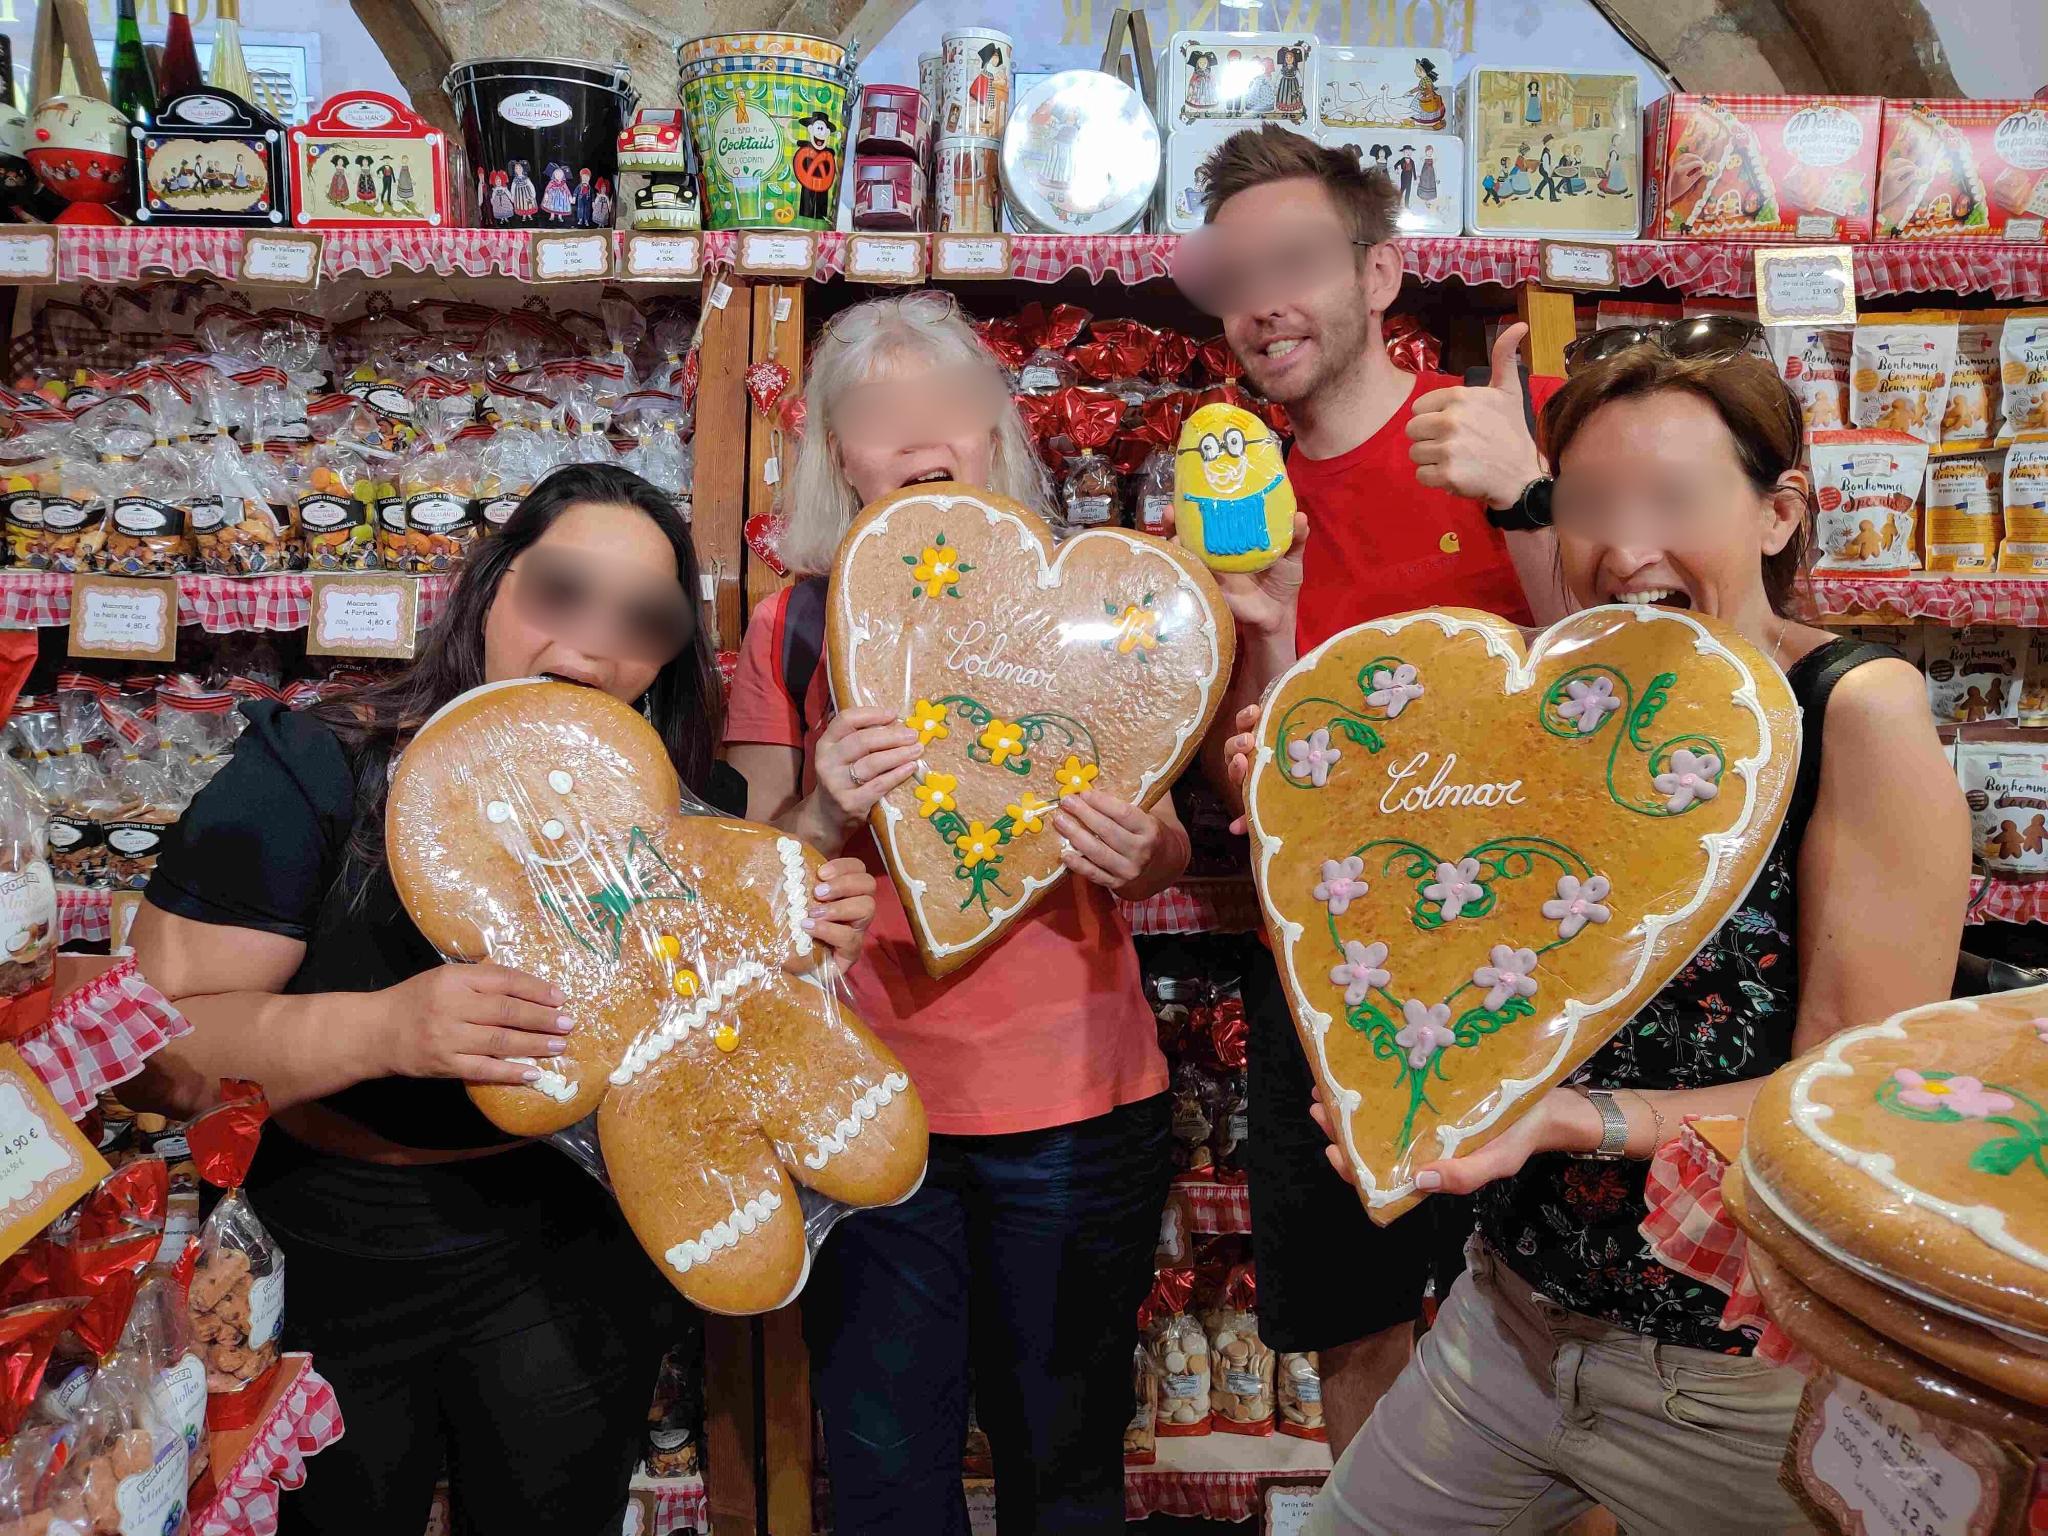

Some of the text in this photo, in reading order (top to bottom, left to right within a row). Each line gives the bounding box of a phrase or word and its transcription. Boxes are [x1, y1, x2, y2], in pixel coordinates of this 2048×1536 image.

[534, 109, 562, 119] HANSI
[718, 135, 775, 157] Cocktails
[1833, 287, 1840, 295] €
[1877, 356, 1939, 371] Bonhommes
[1887, 371, 1930, 382] Caramel
[1879, 380, 1917, 393] Beurre
[1840, 476, 1903, 492] Bonhommes
[145, 500, 165, 510] COCO
[101, 602, 133, 610] Macarons
[144, 622, 151, 630] €
[367, 619, 384, 627] 4,80
[946, 620, 1059, 692] Colmar
[1950, 646, 2010, 661] Bonhommes
[1379, 751, 1527, 814] Colmar
[1984, 775, 2048, 793] Bonhomm
[4, 1127, 39, 1156] 4,90 €
[1858, 1389, 1885, 1426] Pain
[1886, 1422, 1943, 1488] d'Epices
